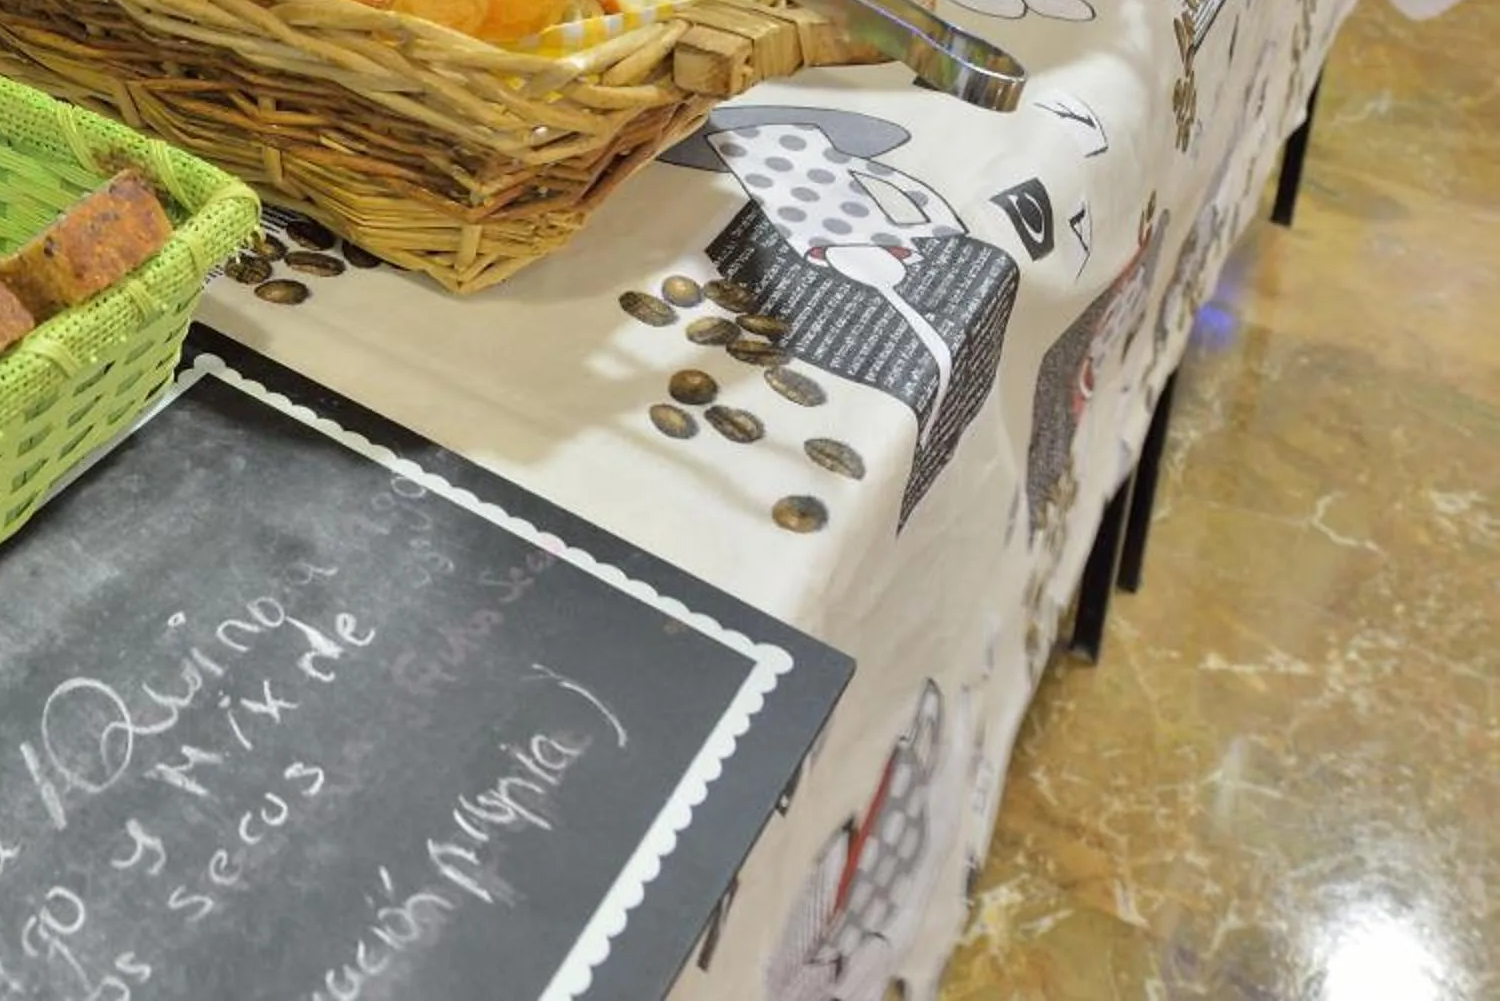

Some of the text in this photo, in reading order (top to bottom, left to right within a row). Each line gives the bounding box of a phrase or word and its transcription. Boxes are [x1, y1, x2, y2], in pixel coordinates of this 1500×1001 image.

[110, 818, 168, 877] y
[143, 679, 300, 797] Mix
[285, 612, 377, 683] de
[312, 864, 457, 1001] ación
